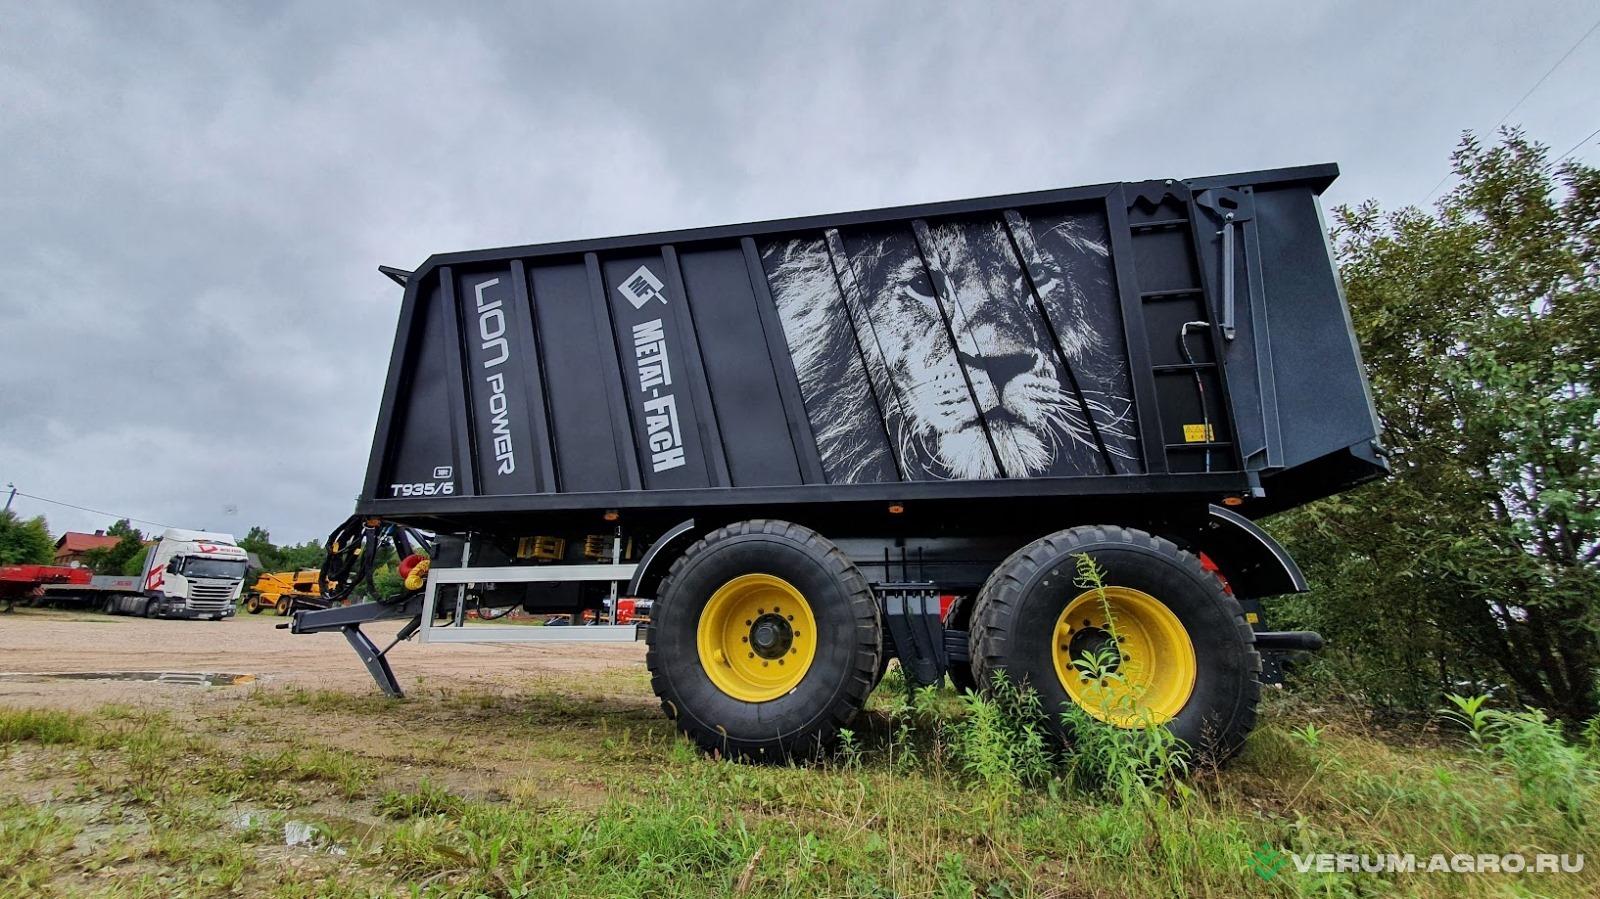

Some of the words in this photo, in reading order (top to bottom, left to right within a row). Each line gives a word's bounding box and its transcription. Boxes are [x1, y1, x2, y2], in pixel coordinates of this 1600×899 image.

[474, 277, 510, 368] LION
[486, 373, 515, 476] POWER
[632, 318, 686, 472] METAL-FACH
[391, 481, 454, 496] T935/6
